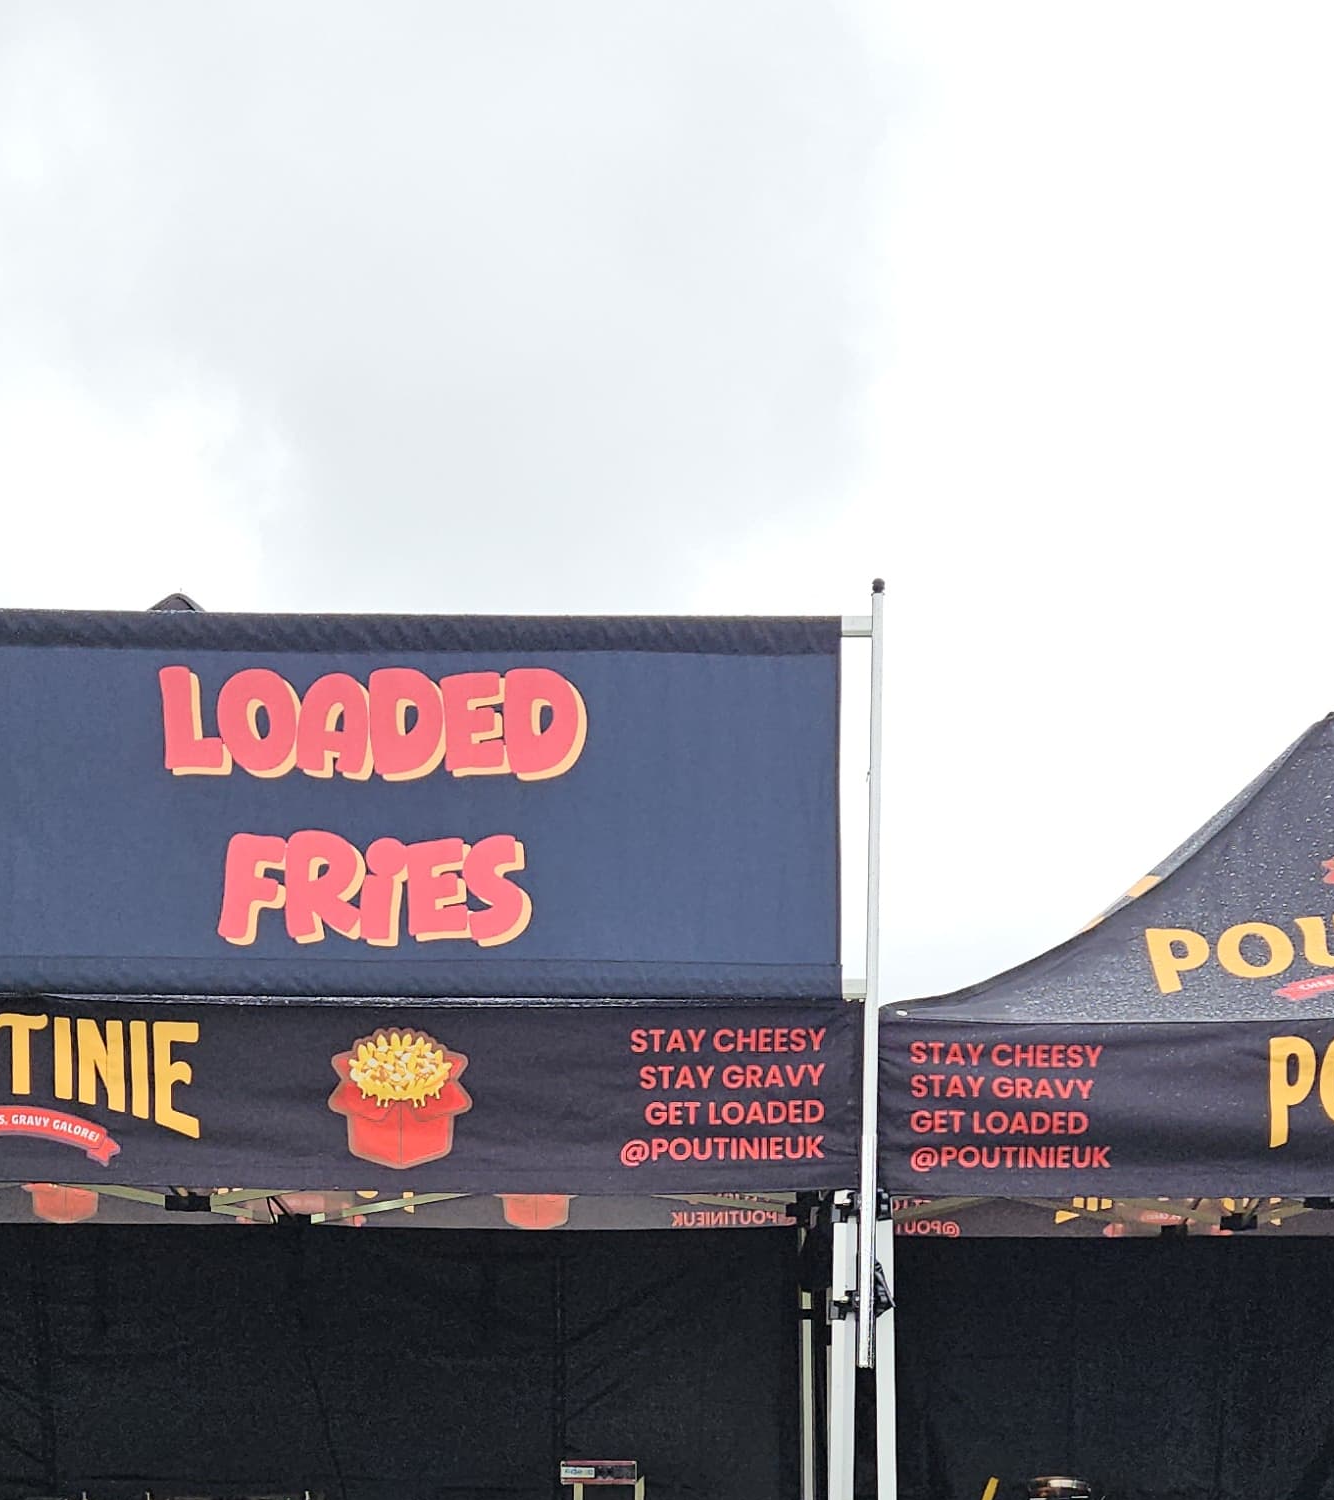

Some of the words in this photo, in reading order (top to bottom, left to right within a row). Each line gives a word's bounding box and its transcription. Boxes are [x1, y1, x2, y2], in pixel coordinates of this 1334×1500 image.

[158, 666, 588, 782] LOADED
[217, 829, 533, 947] FRIES
[631, 1028, 708, 1053] STAY
[713, 1028, 825, 1053] CHEESY
[910, 1041, 985, 1066] STAY
[991, 1044, 1103, 1068] CHEESY
[640, 1065, 715, 1089] STAY
[721, 1063, 825, 1088] GRAVY
[911, 1075, 985, 1097] STAY
[991, 1077, 1094, 1099] GRAVY
[645, 1101, 703, 1125] GET
[709, 1100, 825, 1125] LOADED
[911, 1110, 965, 1133] GET
[973, 1111, 1089, 1134] LOADED
[11, 1114, 50, 1127] GRAVY
[53, 1120, 100, 1142] GALORE!
[620, 1136, 825, 1166] @POUTINIEUK
[910, 1147, 1111, 1172] @POUTINIEUK
